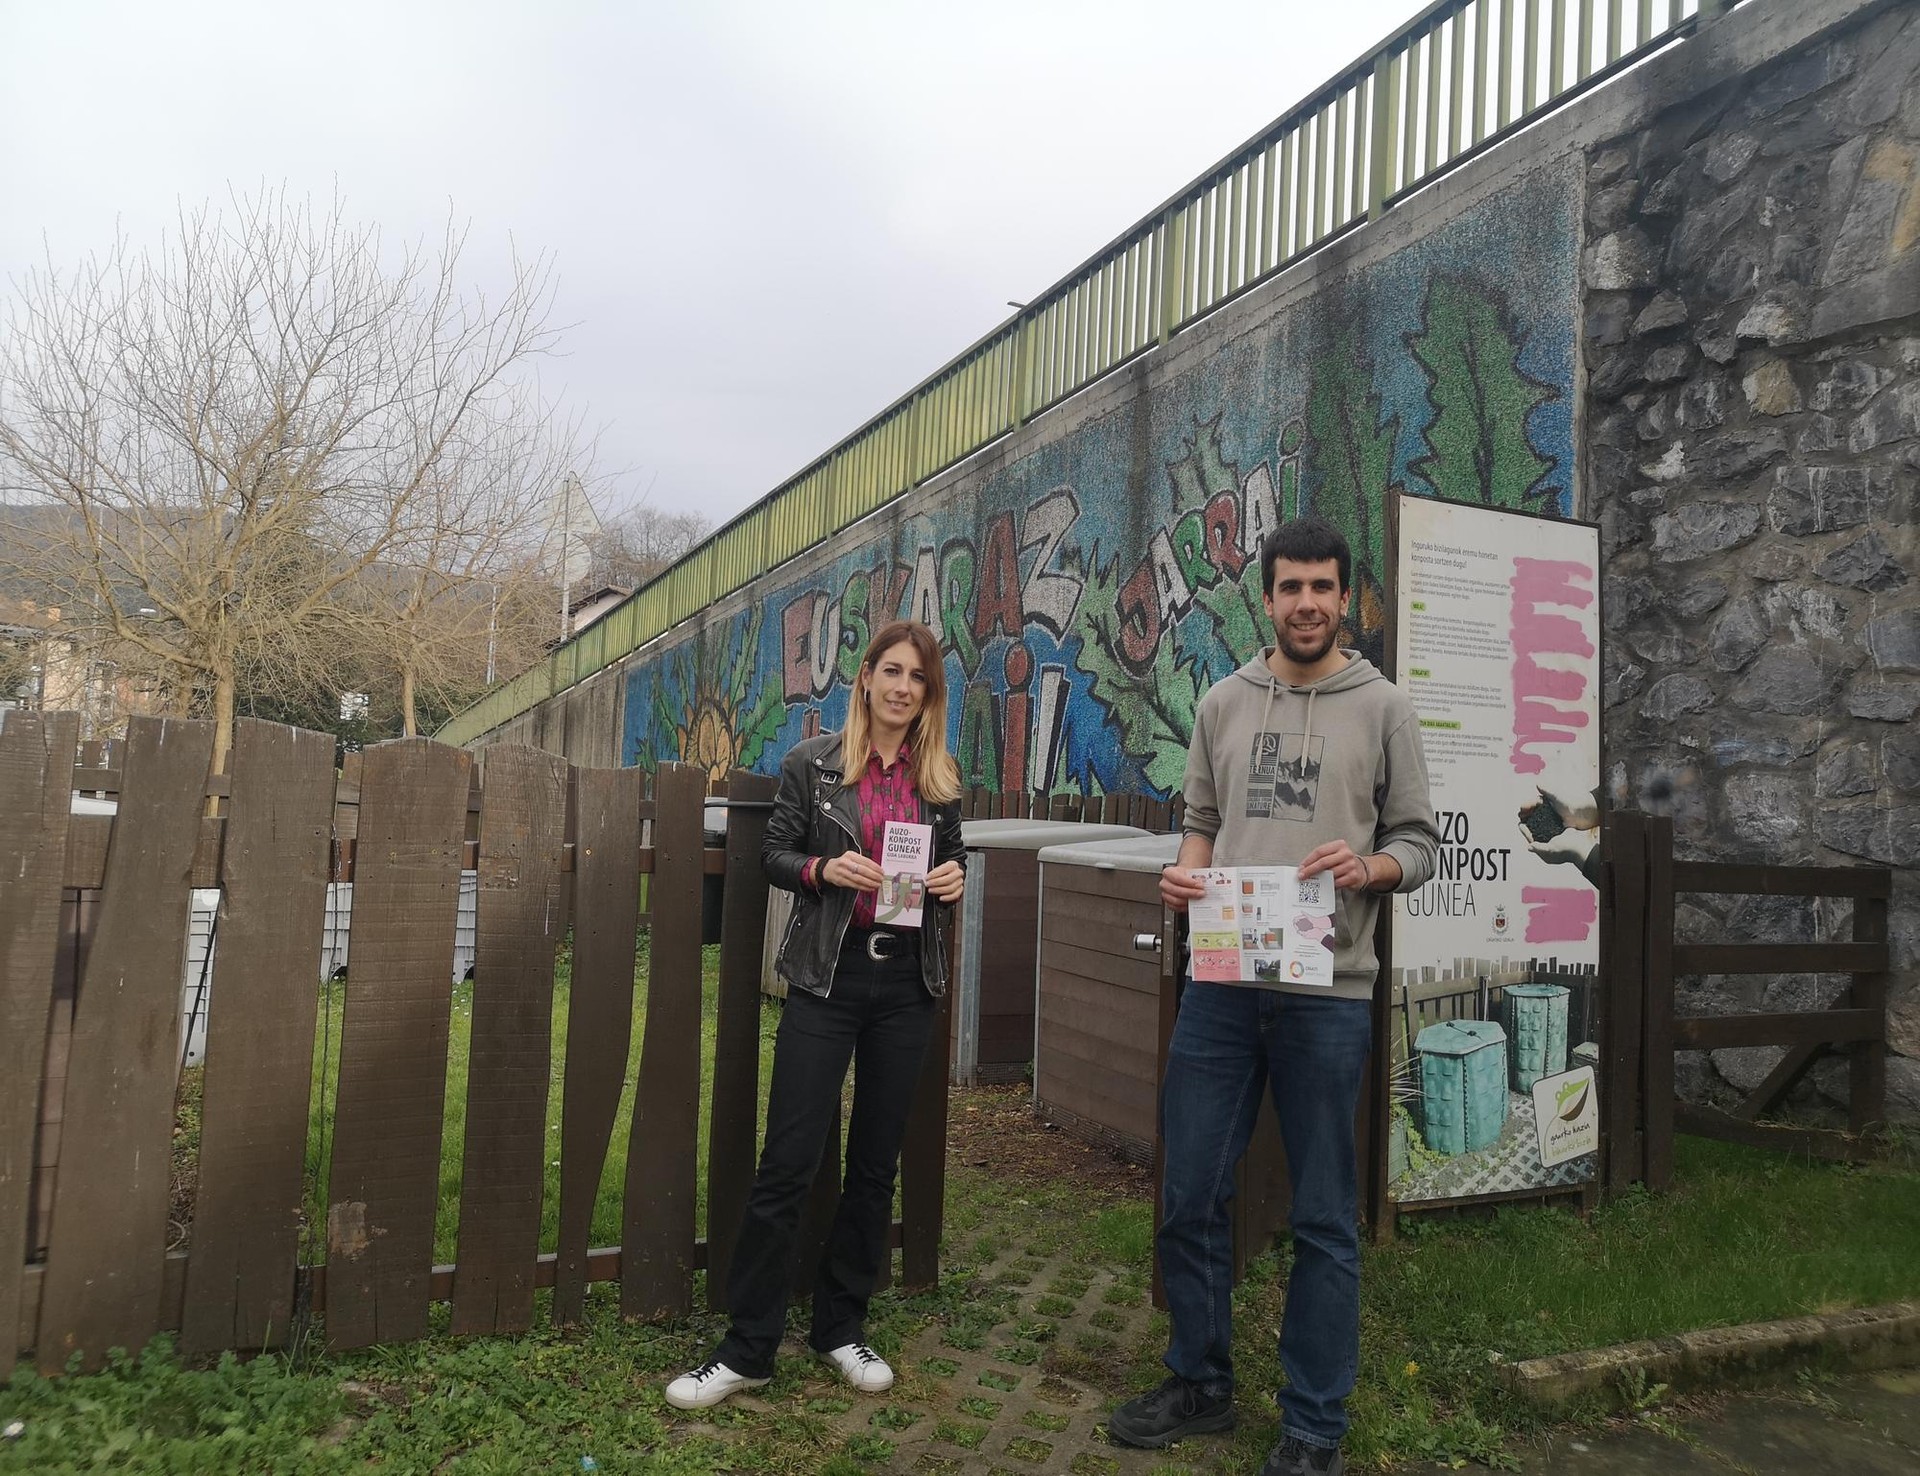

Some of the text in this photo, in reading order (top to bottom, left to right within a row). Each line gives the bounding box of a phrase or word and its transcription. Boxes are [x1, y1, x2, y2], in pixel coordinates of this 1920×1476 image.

[779, 488, 1084, 703] EUSKARAZ
[1249, 765, 1276, 775] TERNUA
[889, 827, 912, 837] AUZO-
[888, 835, 922, 845] KONPOST
[887, 844, 921, 855] GUNEAK
[1438, 847, 1511, 881] NPOST
[1406, 883, 1476, 917] GUNEA
